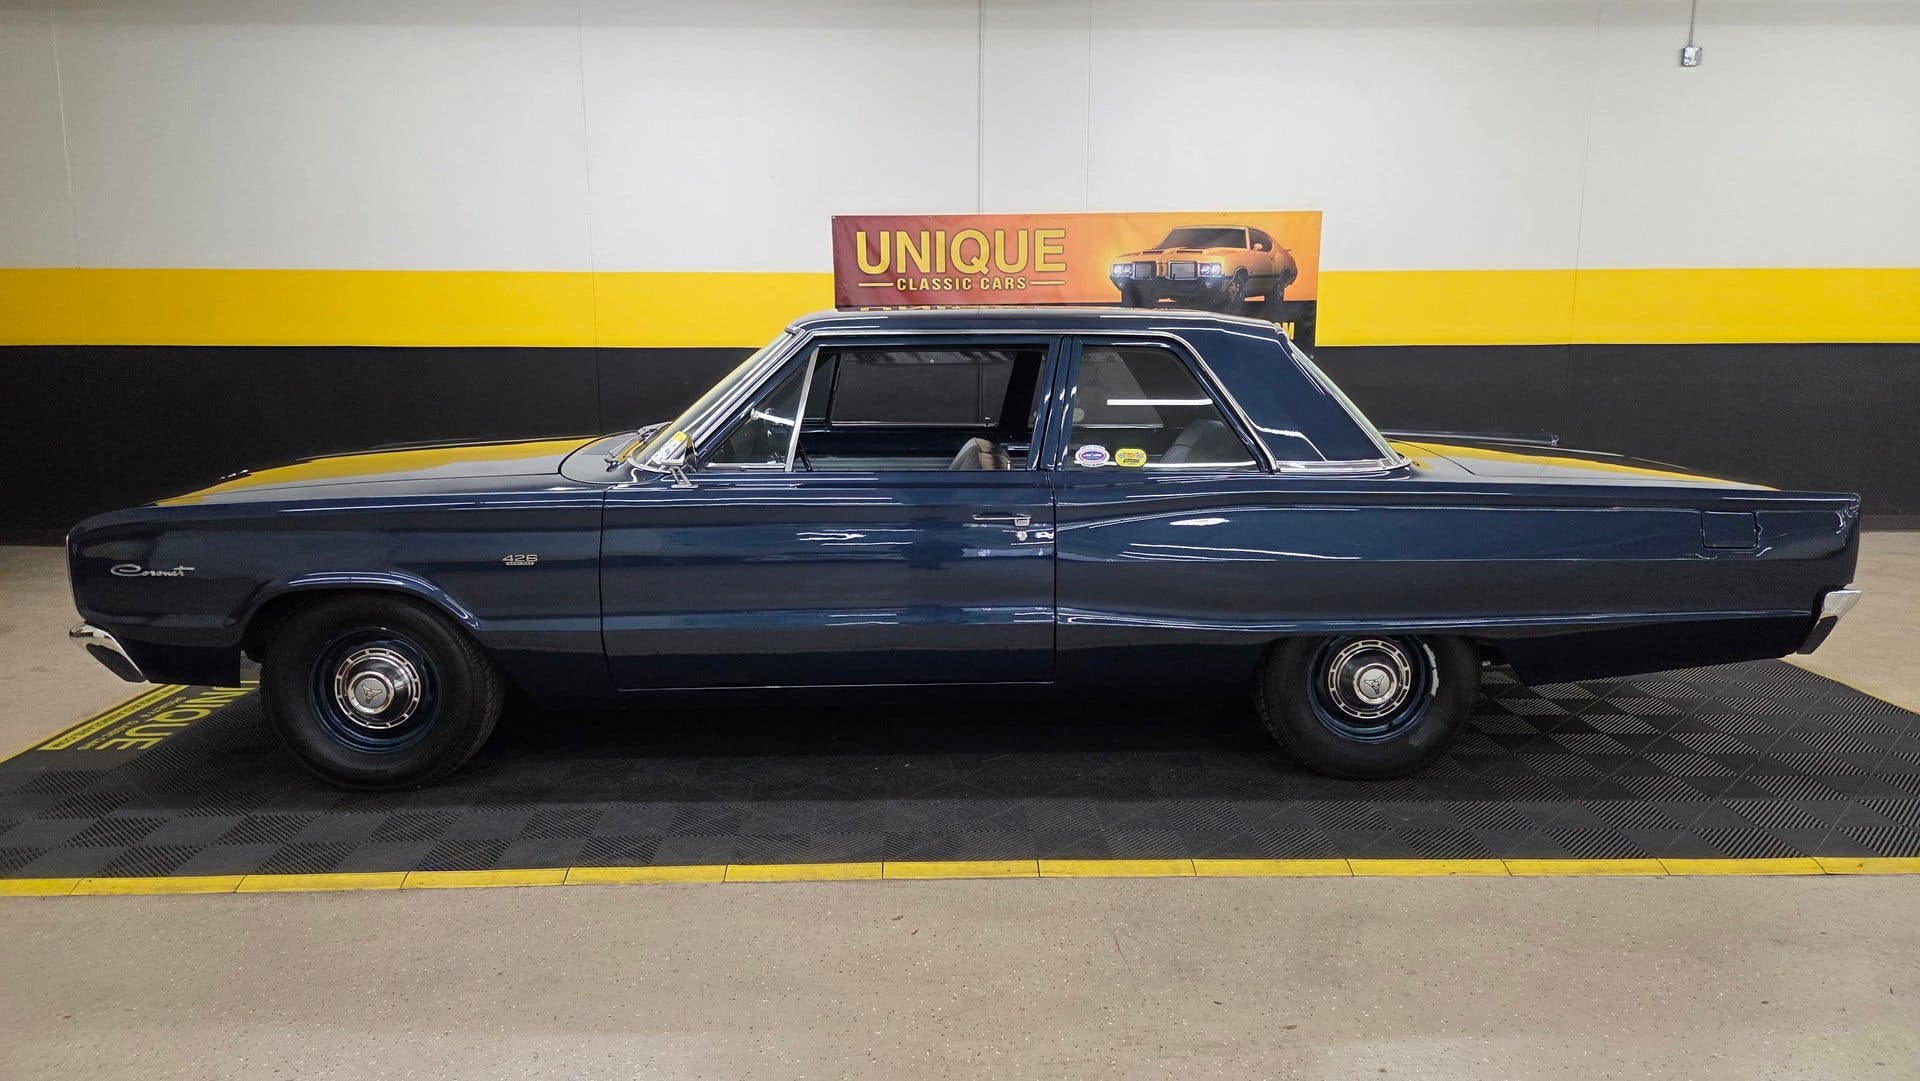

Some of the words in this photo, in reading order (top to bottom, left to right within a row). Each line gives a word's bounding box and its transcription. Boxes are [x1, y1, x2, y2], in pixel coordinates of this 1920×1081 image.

[856, 228, 1066, 275] UNIQUE
[896, 276, 972, 291] CLASSIC
[980, 276, 1027, 290] CARS
[501, 554, 538, 562] 426
[110, 563, 195, 577] Coronet
